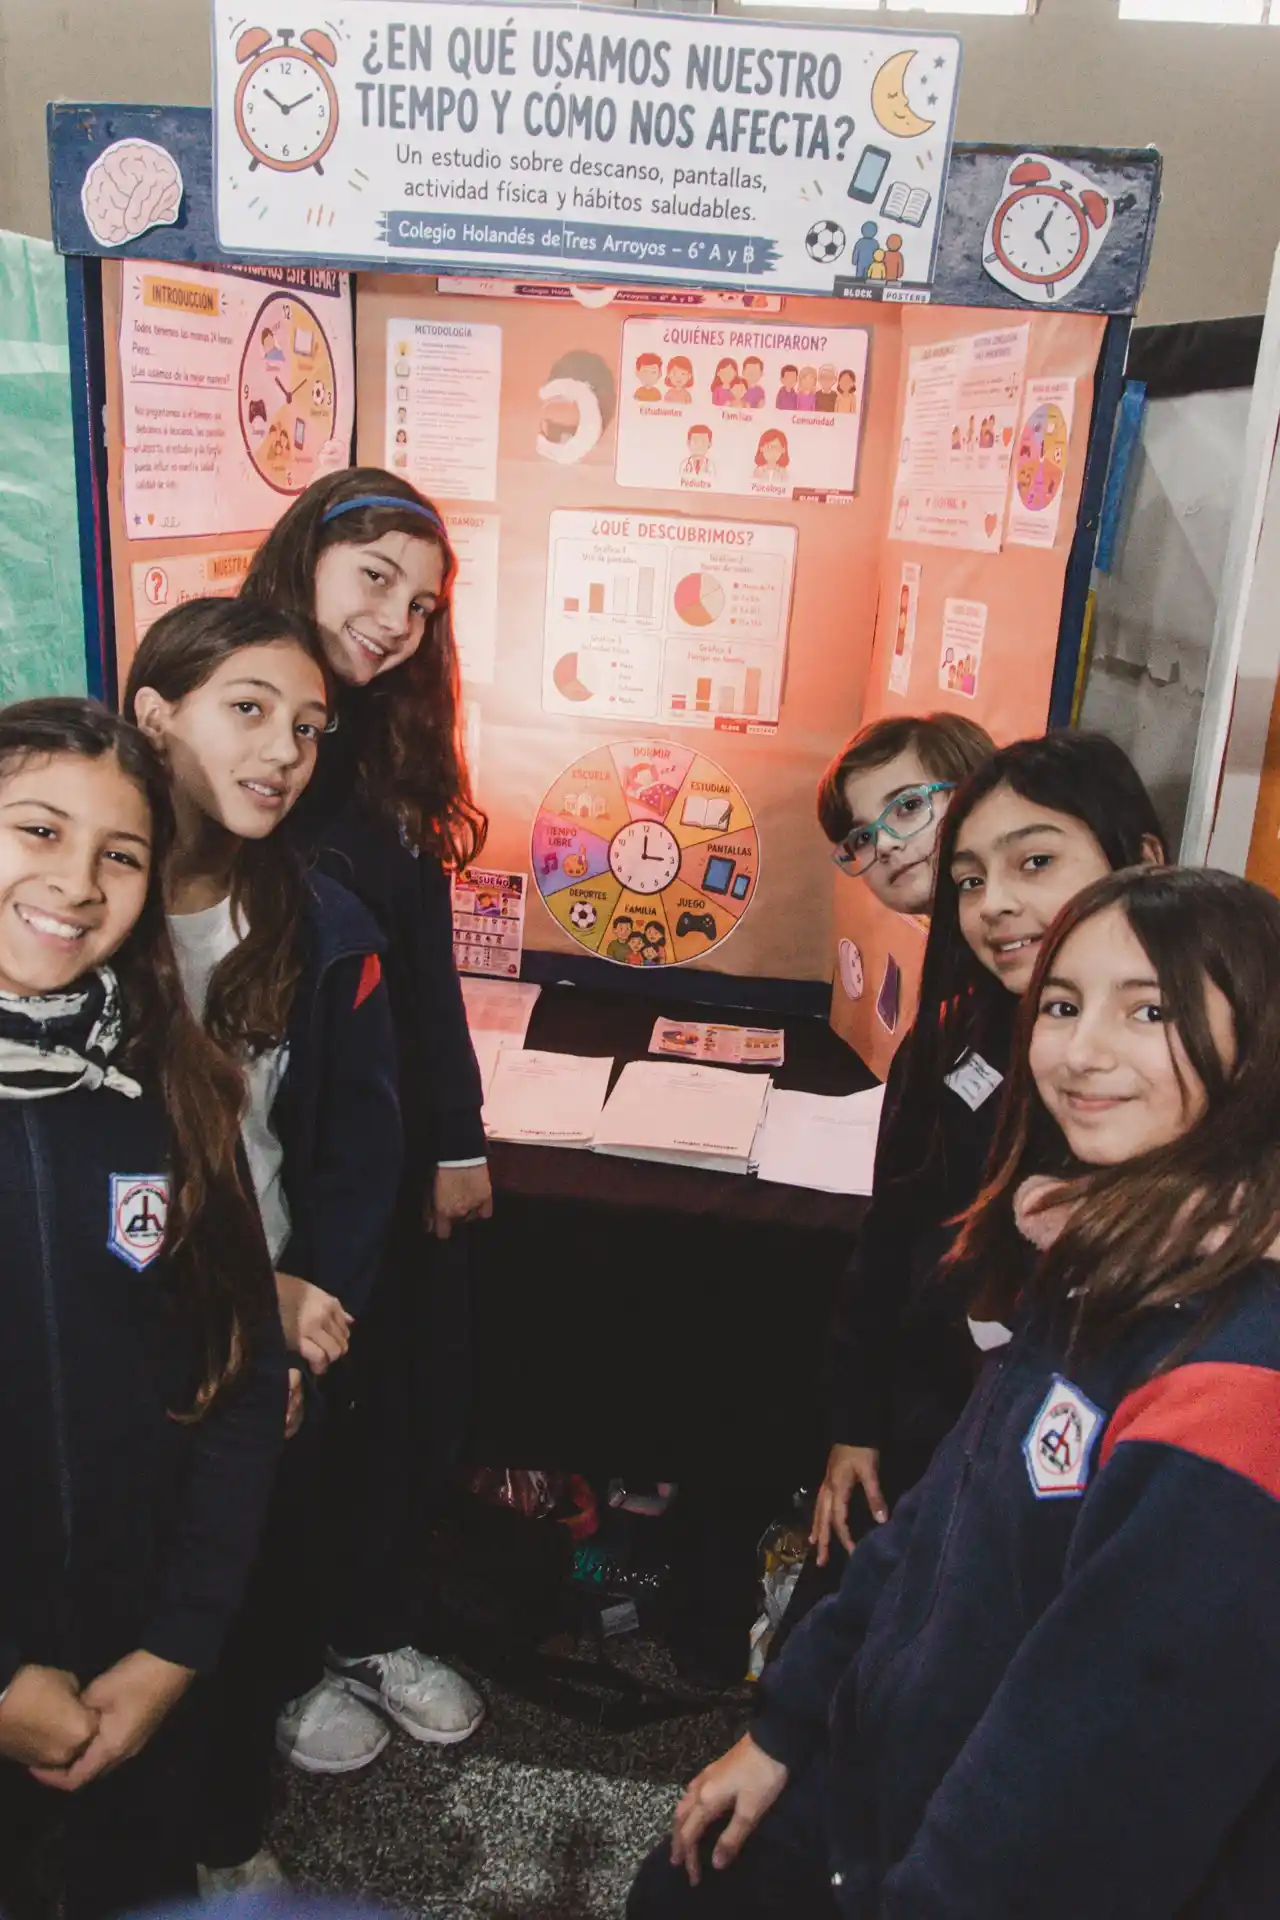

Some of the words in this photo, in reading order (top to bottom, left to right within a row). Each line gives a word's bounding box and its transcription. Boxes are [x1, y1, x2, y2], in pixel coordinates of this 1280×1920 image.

[362, 22, 433, 75] ¿EN
[447, 17, 518, 80] QUÉ
[531, 29, 672, 88] USAMOS
[685, 43, 842, 100] NUESTRO
[279, 62, 292, 75] 12
[246, 102, 254, 114] 9
[318, 105, 325, 118] 3
[355, 81, 479, 134] TIEMPO
[490, 89, 512, 135] Y
[523, 82, 617, 142] CÓMO
[629, 99, 696, 149] NOS
[705, 106, 856, 162] AFECTA?
[281, 143, 290, 157] 6
[395, 143, 423, 165] Un
[431, 148, 502, 170] estudio
[509, 150, 563, 173] sobre
[569, 154, 664, 184] descanso,
[672, 166, 767, 193] pantallas,
[403, 177, 489, 201] actividad
[496, 181, 548, 205] física
[556, 190, 567, 211] y
[572, 185, 642, 212] hábitos
[651, 194, 757, 221] saludables.
[398, 220, 456, 244] Colegio
[462, 223, 536, 246] Holandés
[541, 229, 561, 246] de
[563, 231, 597, 250] Tres
[602, 234, 666, 261] Arroyos
[708, 244, 721, 260] A
[726, 250, 737, 268] y
[742, 246, 756, 264] B
[151, 282, 214, 311] INTRODUCCIÓN
[843, 287, 873, 299] BLOCK
[282, 304, 291, 320] 12
[414, 324, 473, 338] METODOLOGÍA
[663, 326, 725, 346] ¿QUIÉNES
[729, 331, 828, 352] PARTICIPARON?
[243, 384, 250, 400] 9
[791, 415, 835, 427] Comunidad
[591, 518, 630, 537] ¿QUÉ
[638, 523, 755, 546] DESCUBRIMOS?
[633, 746, 671, 759] DORMIR
[571, 769, 611, 782] ESCUELA
[690, 781, 731, 794] ESTUDIAR
[548, 837, 573, 848] LIBRE
[706, 843, 752, 857] PANTALLAS
[569, 888, 607, 901] DEPORTES
[624, 904, 657, 916] FAMILIA
[677, 898, 706, 910] JUEGO
